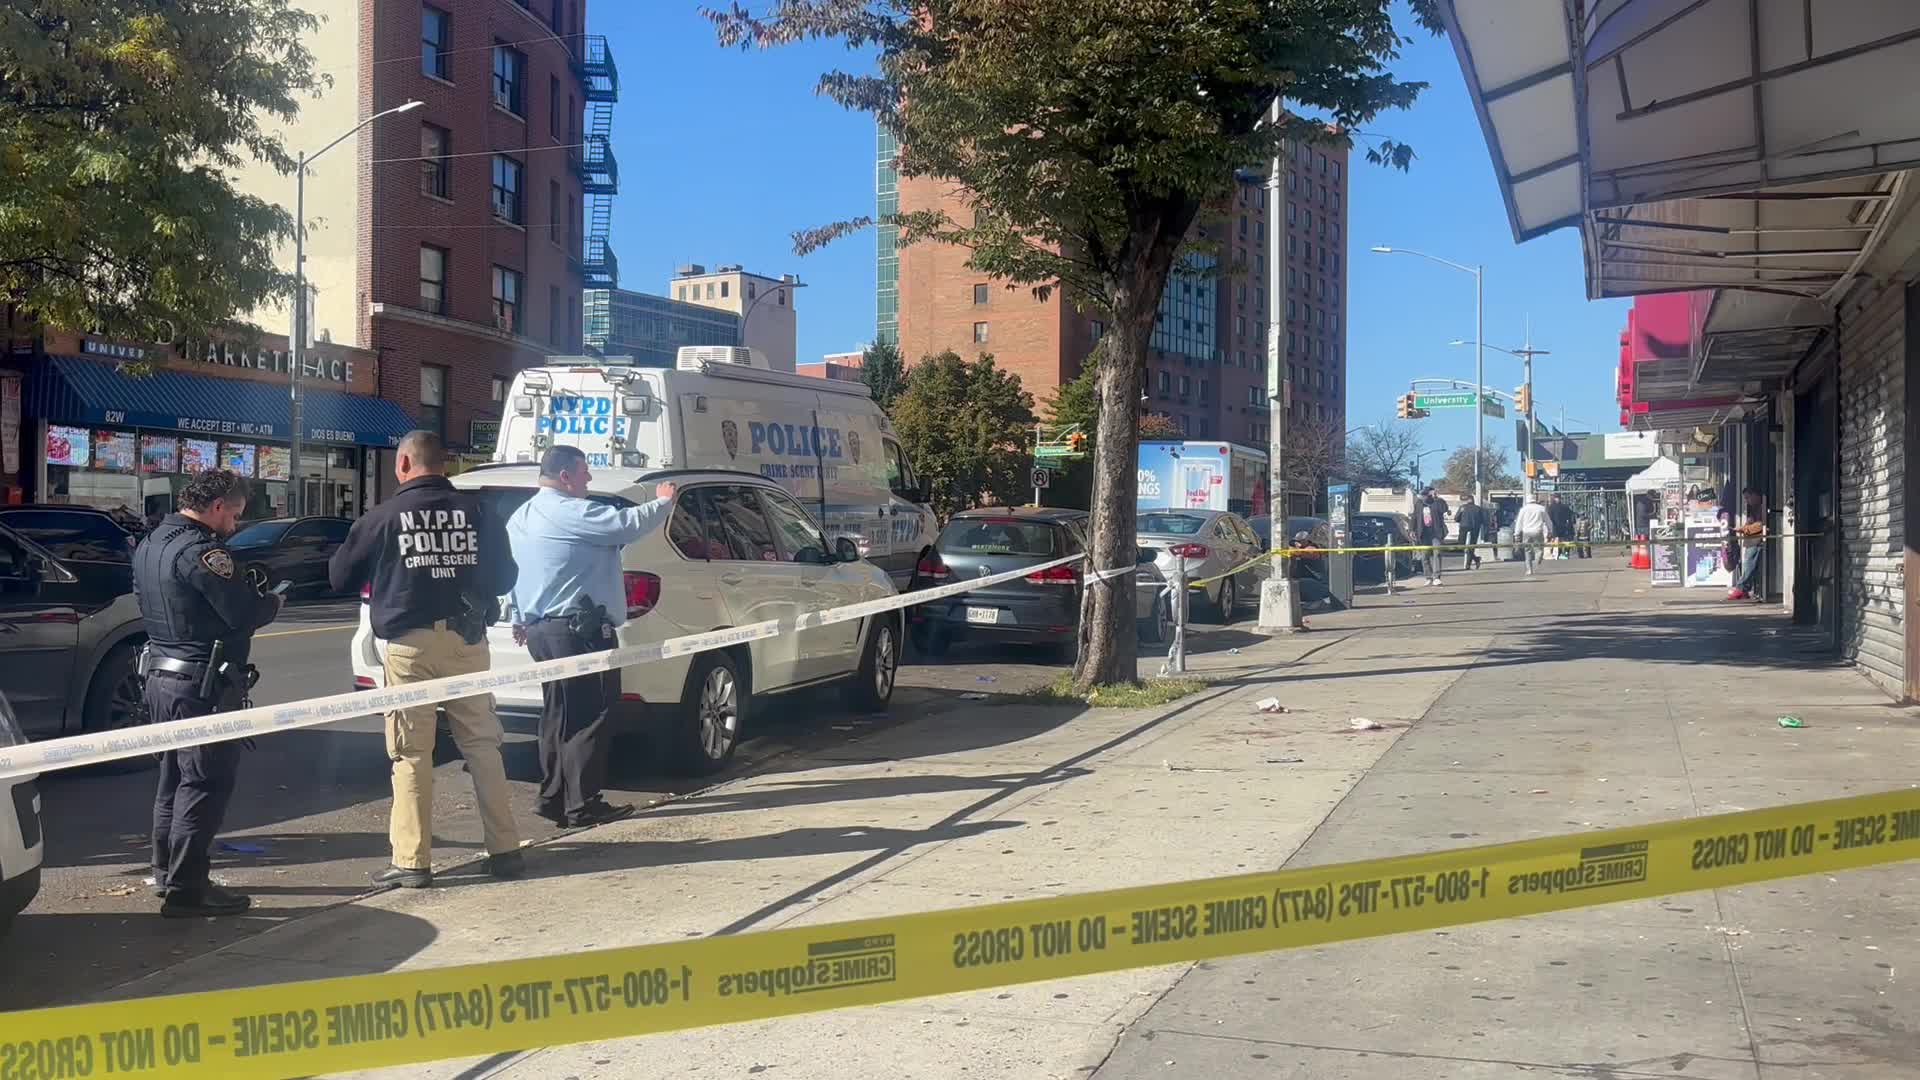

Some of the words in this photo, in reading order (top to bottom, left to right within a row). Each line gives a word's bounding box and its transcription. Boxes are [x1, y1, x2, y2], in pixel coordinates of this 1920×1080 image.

[551, 395, 611, 415] NYPD
[1423, 396, 1468, 406] University
[105, 410, 125, 423] 82W
[178, 417, 190, 429] WE
[190, 419, 220, 432] ACCEPT
[221, 421, 236, 433] EBT
[259, 424, 273, 435] ATM
[537, 416, 626, 434] POLICE
[311, 428, 326, 440] DIOS
[326, 430, 335, 440] ES
[748, 421, 843, 458] POLICE
[586, 453, 609, 466] CEN
[1137, 469, 1156, 483] 0%
[1137, 482, 1161, 496] NGS
[400, 510, 472, 532] N.Y.P.D.
[398, 531, 478, 556] POLICE
[405, 554, 440, 569] CRIME
[443, 553, 478, 566] SCENE
[431, 567, 456, 578] UNIT
